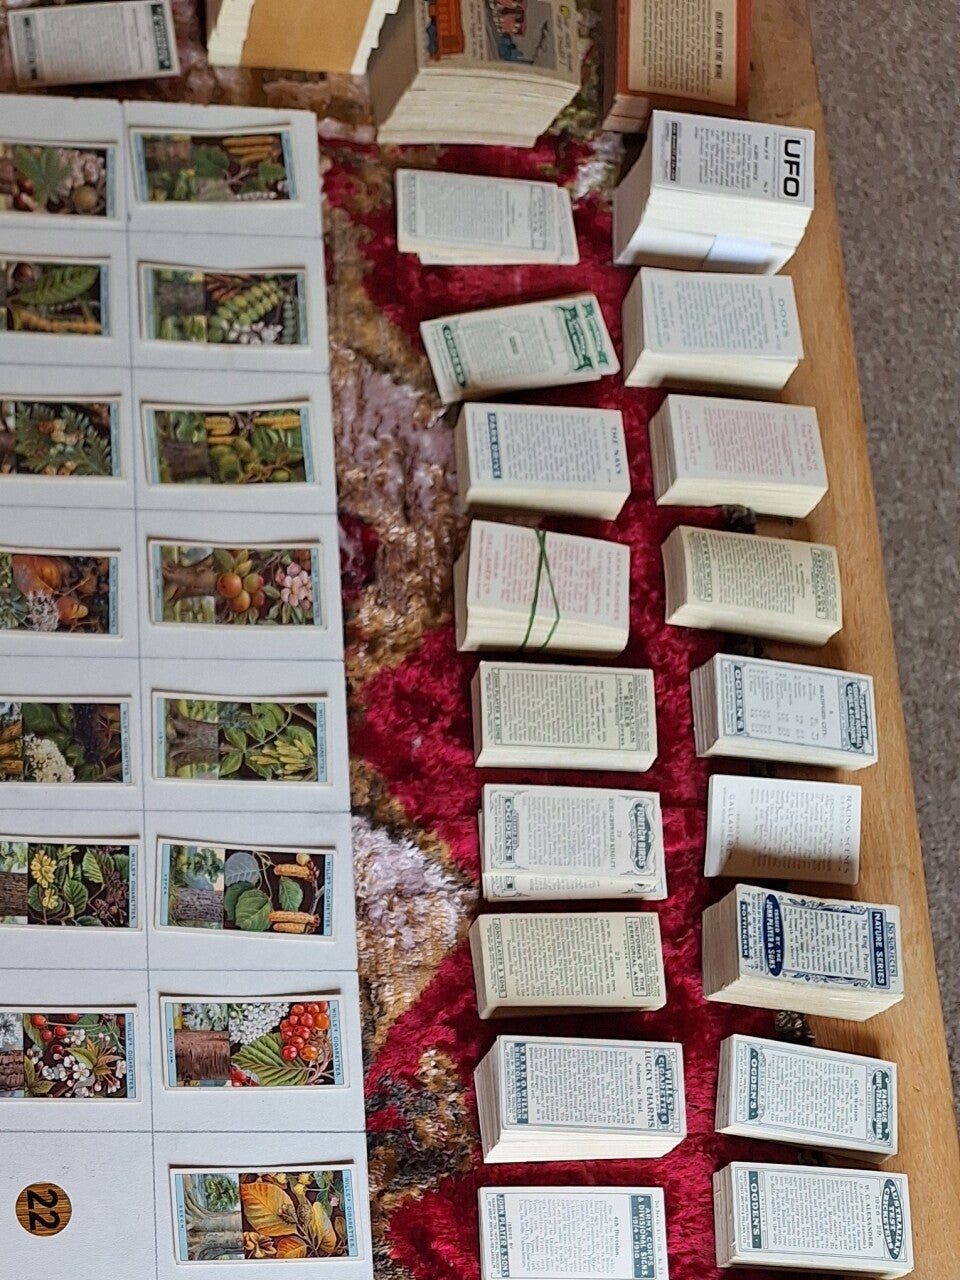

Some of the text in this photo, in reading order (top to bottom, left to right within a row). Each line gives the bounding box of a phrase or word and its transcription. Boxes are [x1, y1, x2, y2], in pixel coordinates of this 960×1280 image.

[783, 139, 800, 196] UFO
[778, 299, 788, 337] DOGS
[488, 415, 500, 477] PARK DRIVE
[813, 552, 822, 612] FOOTBALLERS
[817, 553, 825, 612] ASSOCIATION
[734, 669, 743, 729] OGDEN'S
[862, 727, 867, 737] OF
[637, 806, 645, 840] FOREIGN
[628, 921, 636, 968] TERRITORIAL
[633, 921, 641, 961] UNIFORMS
[637, 963, 642, 974] OF
[874, 913, 885, 984] NATURE SERIES
[645, 1050, 653, 1082] LUCKY
[658, 1057, 667, 1122] CIGARETTES
[750, 1059, 758, 1109] OGDEN'S
[27, 1189, 60, 1230] 22
[499, 1217, 507, 1247] PLAYER
[751, 1183, 760, 1235] OGDEN'S
[882, 1187, 892, 1249] CRICKETERS
[889, 1185, 901, 1255] AUSTRALIAN
